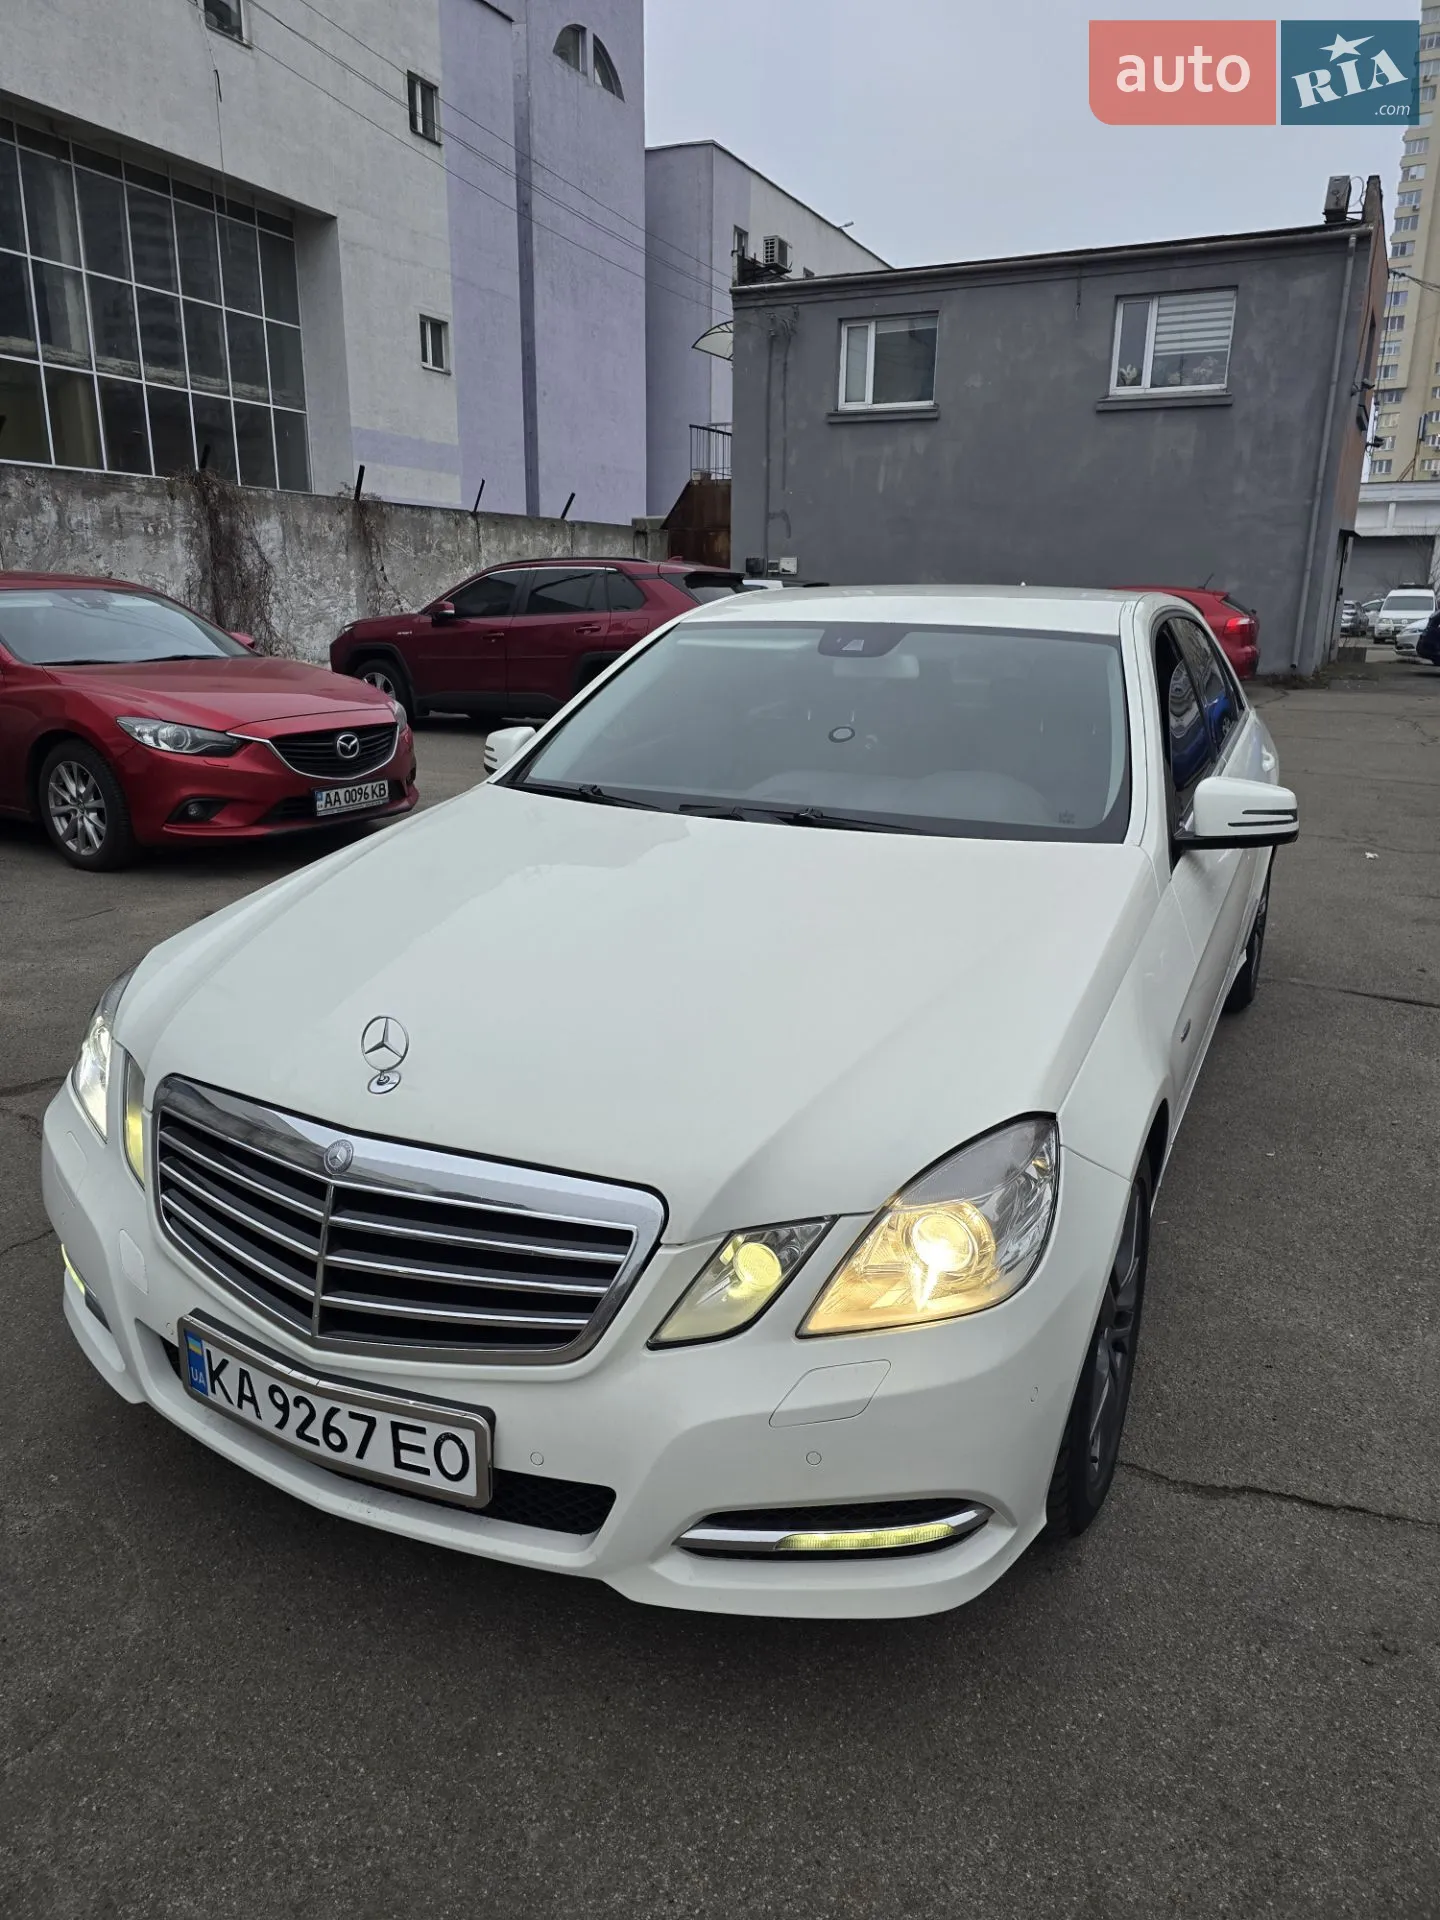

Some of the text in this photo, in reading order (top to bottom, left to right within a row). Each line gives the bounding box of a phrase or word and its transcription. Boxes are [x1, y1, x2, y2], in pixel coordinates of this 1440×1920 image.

[324, 791, 342, 808] AA
[344, 786, 370, 804] 0096
[371, 782, 387, 799] KB
[191, 1366, 206, 1387] UA
[205, 1348, 470, 1482] KA 9267 EO
